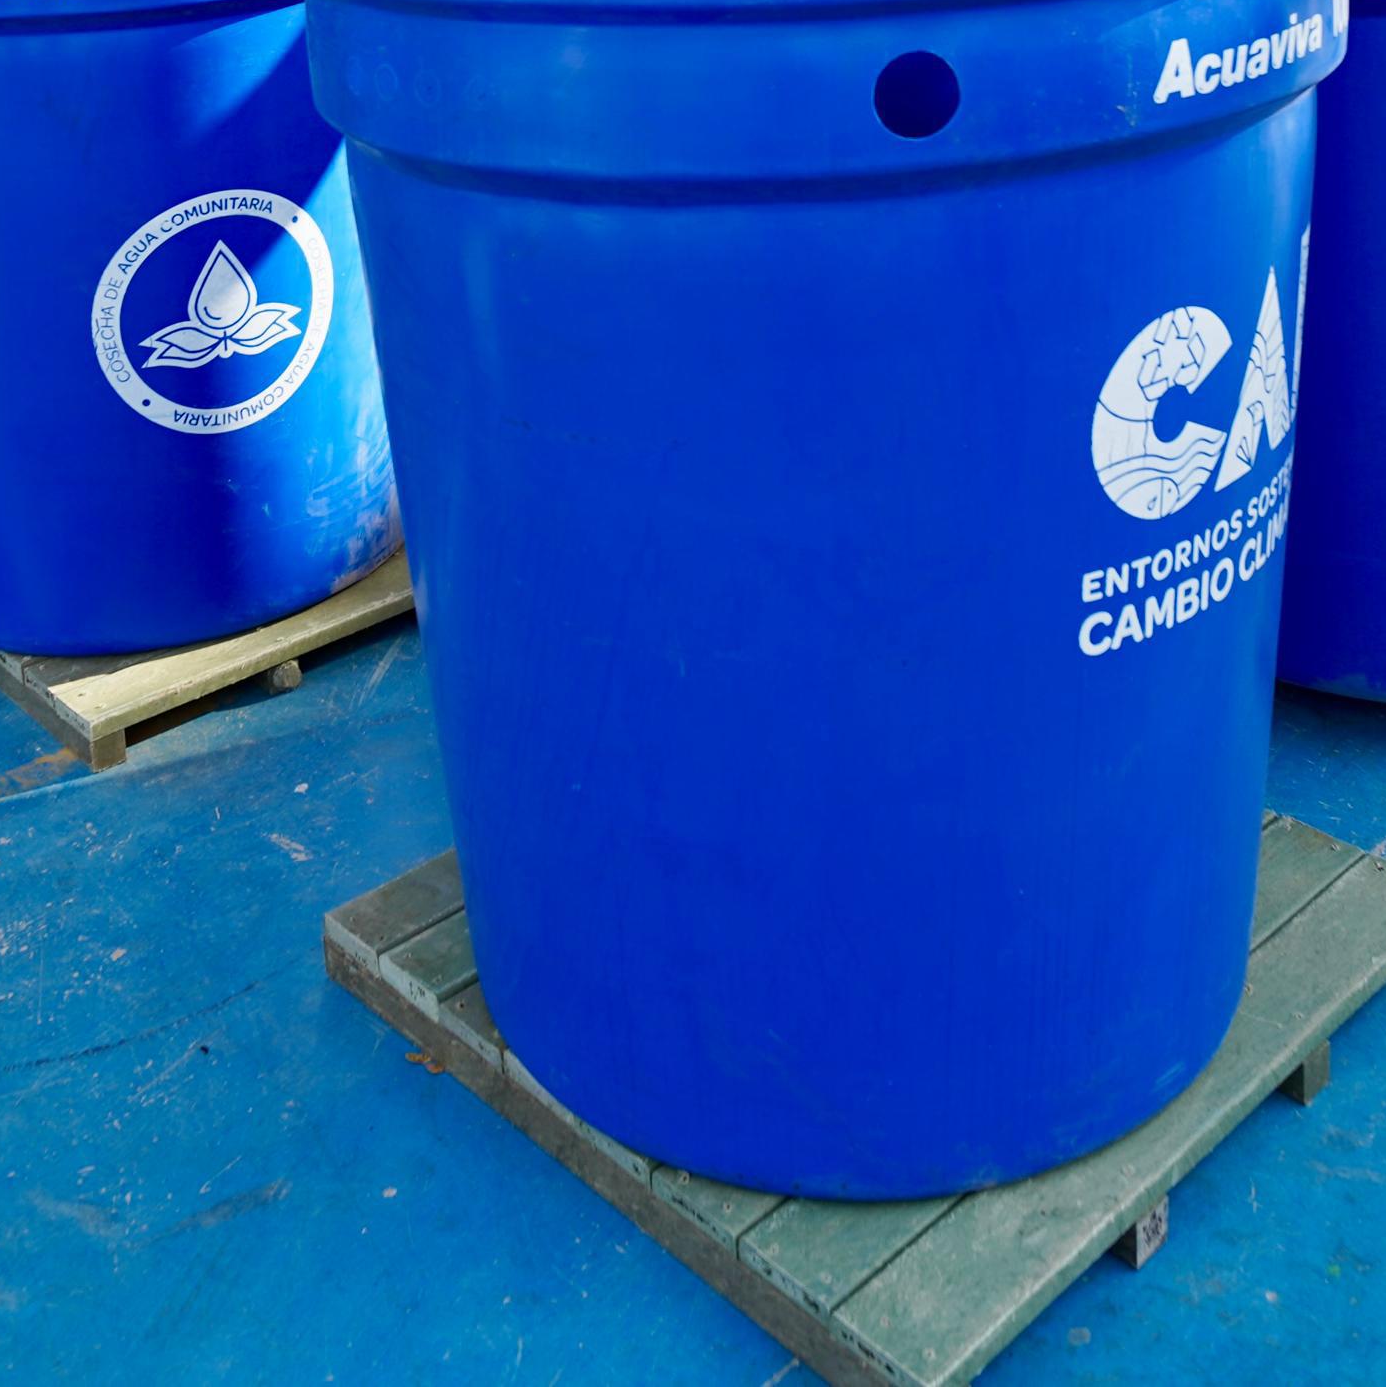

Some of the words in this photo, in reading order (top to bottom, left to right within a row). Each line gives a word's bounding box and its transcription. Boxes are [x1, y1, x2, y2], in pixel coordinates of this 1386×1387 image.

[1153, 13, 1323, 104] Acuaviva
[160, 196, 274, 234] COMUNITARIA
[117, 232, 159, 276] AGUA
[104, 277, 124, 301] DE
[99, 305, 132, 384] COSECHA
[173, 384, 285, 428] COMUNITARIA
[1081, 509, 1243, 603] ENTORNOS
[1078, 556, 1235, 657] CAMBIO
